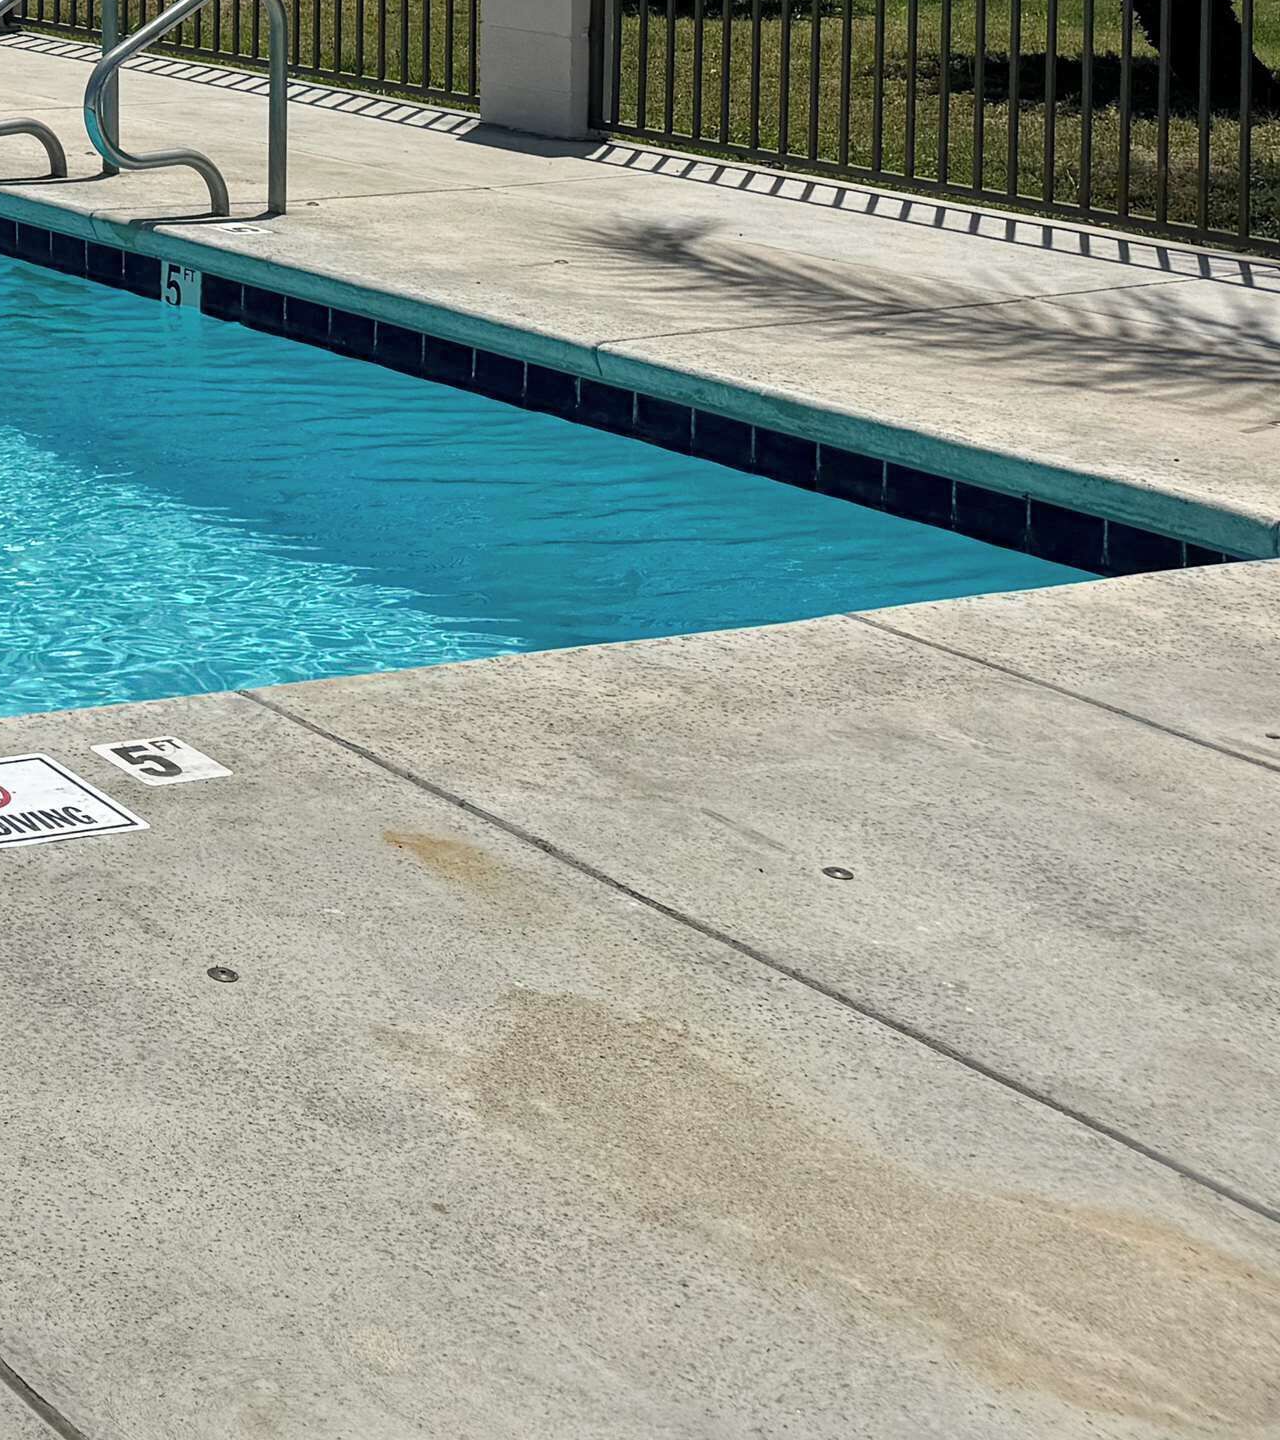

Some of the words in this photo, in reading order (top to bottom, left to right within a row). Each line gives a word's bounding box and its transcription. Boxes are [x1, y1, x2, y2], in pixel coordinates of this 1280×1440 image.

[165, 263, 182, 307] 5
[110, 745, 182, 777] 5
[148, 739, 182, 752] FT
